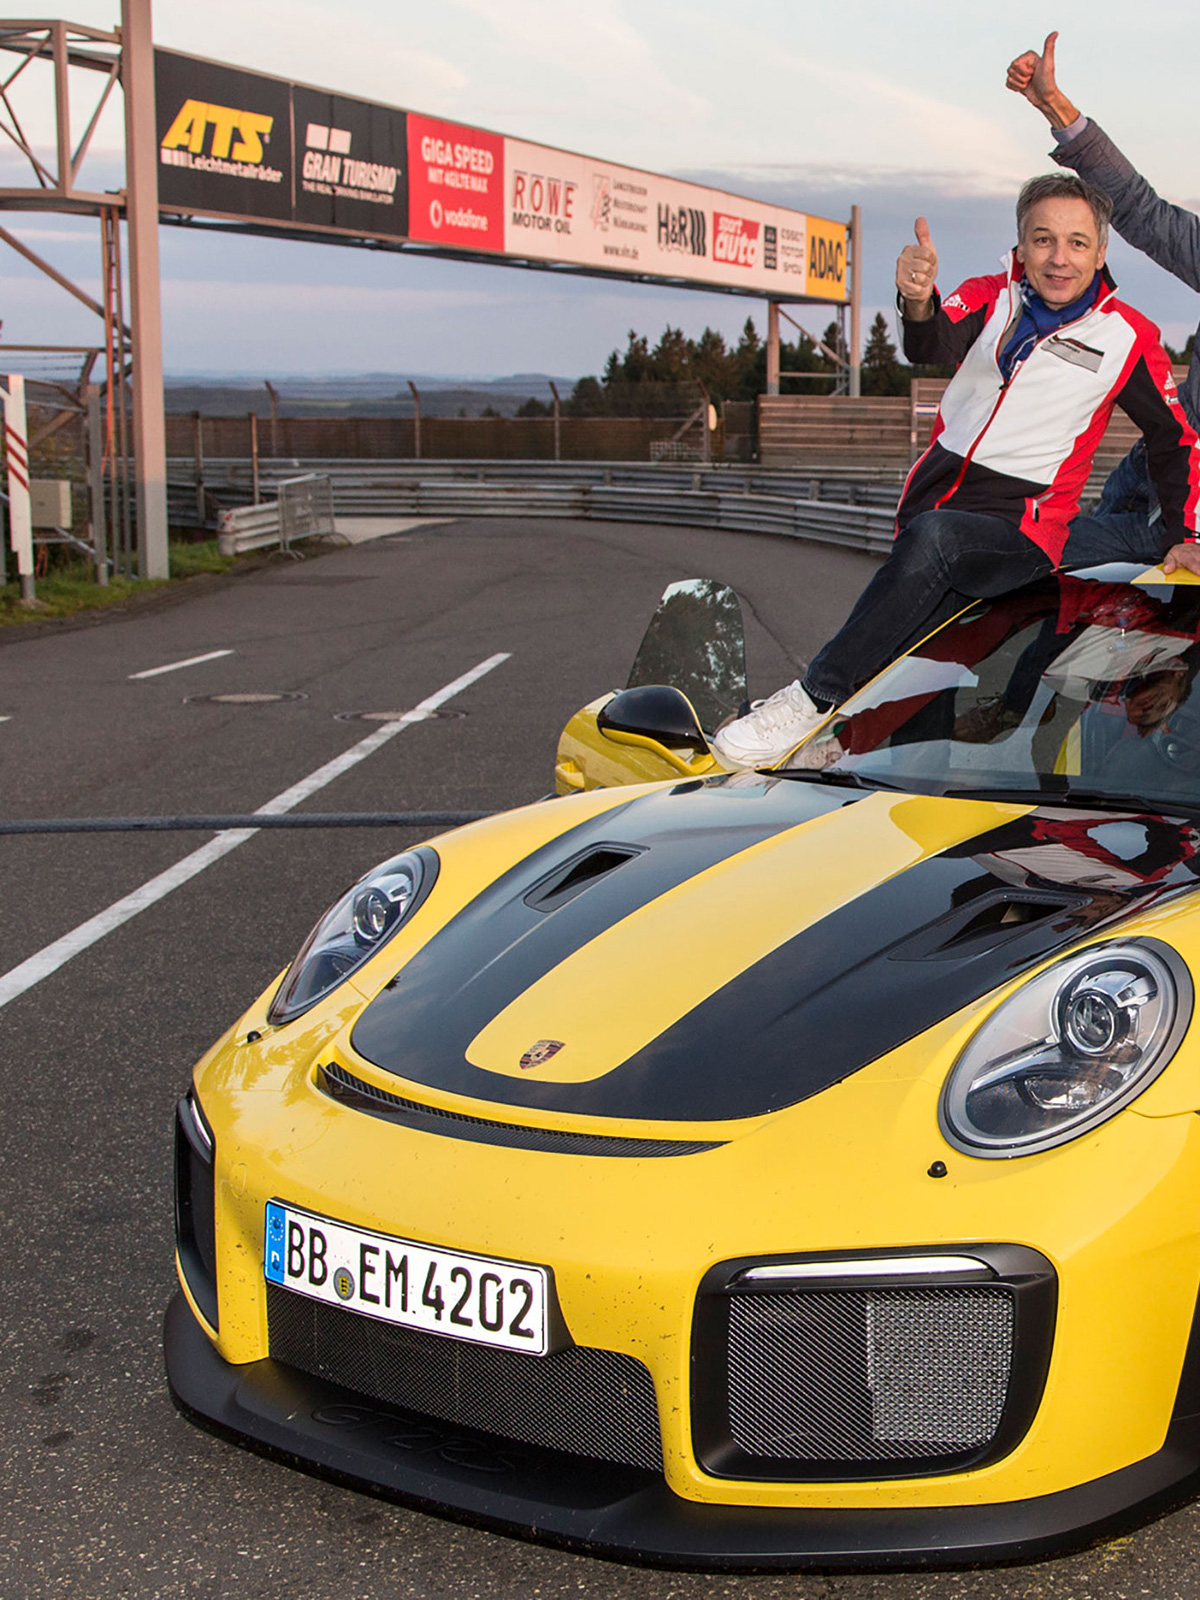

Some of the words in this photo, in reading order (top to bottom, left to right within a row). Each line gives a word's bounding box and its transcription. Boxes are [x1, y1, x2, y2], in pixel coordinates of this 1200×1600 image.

[160, 98, 274, 164] ATS
[302, 150, 341, 185] GRAN
[342, 157, 398, 194] TURISMO
[421, 135, 454, 167] GIGA
[454, 143, 494, 175] SPEED
[443, 206, 488, 232] vodafone
[512, 175, 575, 219] ROWE
[512, 210, 552, 232] MOTOR
[657, 201, 688, 248] H&R
[714, 231, 758, 266] auto
[808, 234, 844, 283] ADAC
[287, 1219, 329, 1287] BB
[421, 1260, 535, 1339] 4202
